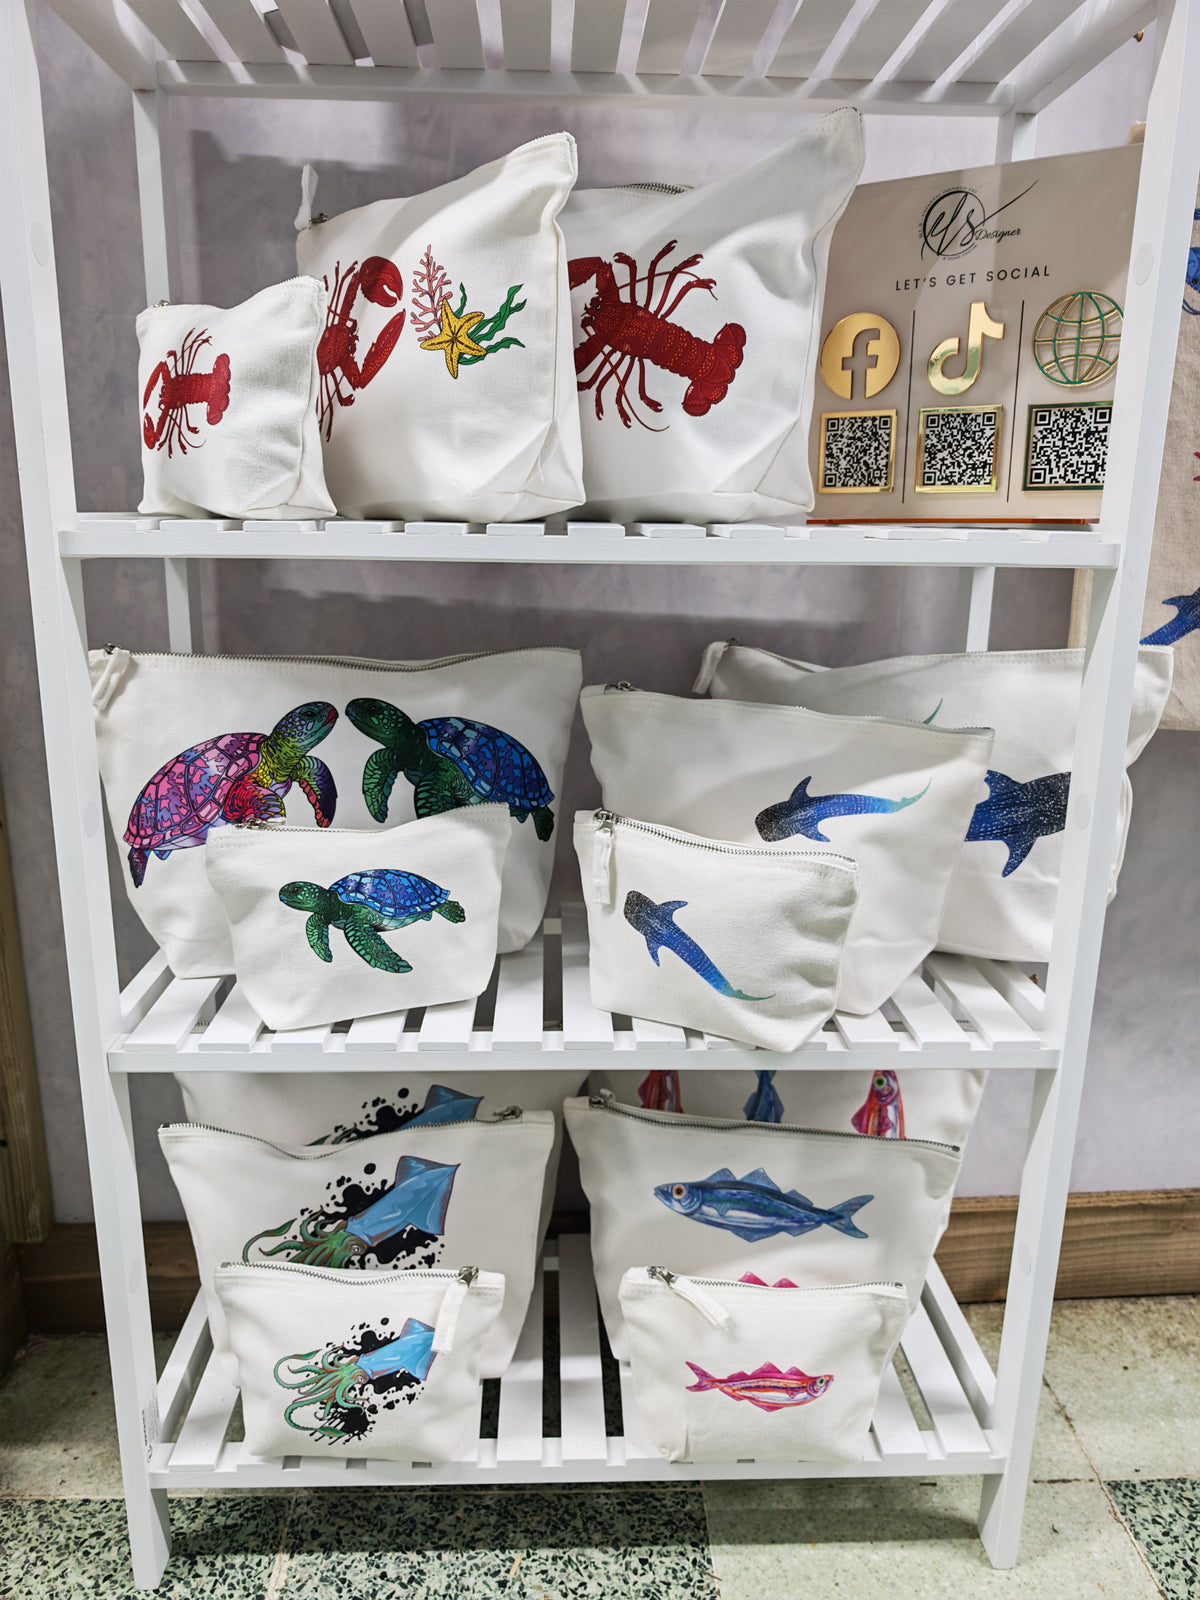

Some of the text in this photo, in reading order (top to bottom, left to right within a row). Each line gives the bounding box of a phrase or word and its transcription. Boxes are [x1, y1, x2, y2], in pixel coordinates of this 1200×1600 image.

[974, 227, 1022, 244] Designer
[895, 265, 1051, 291] LET'S GET SOCIAL
